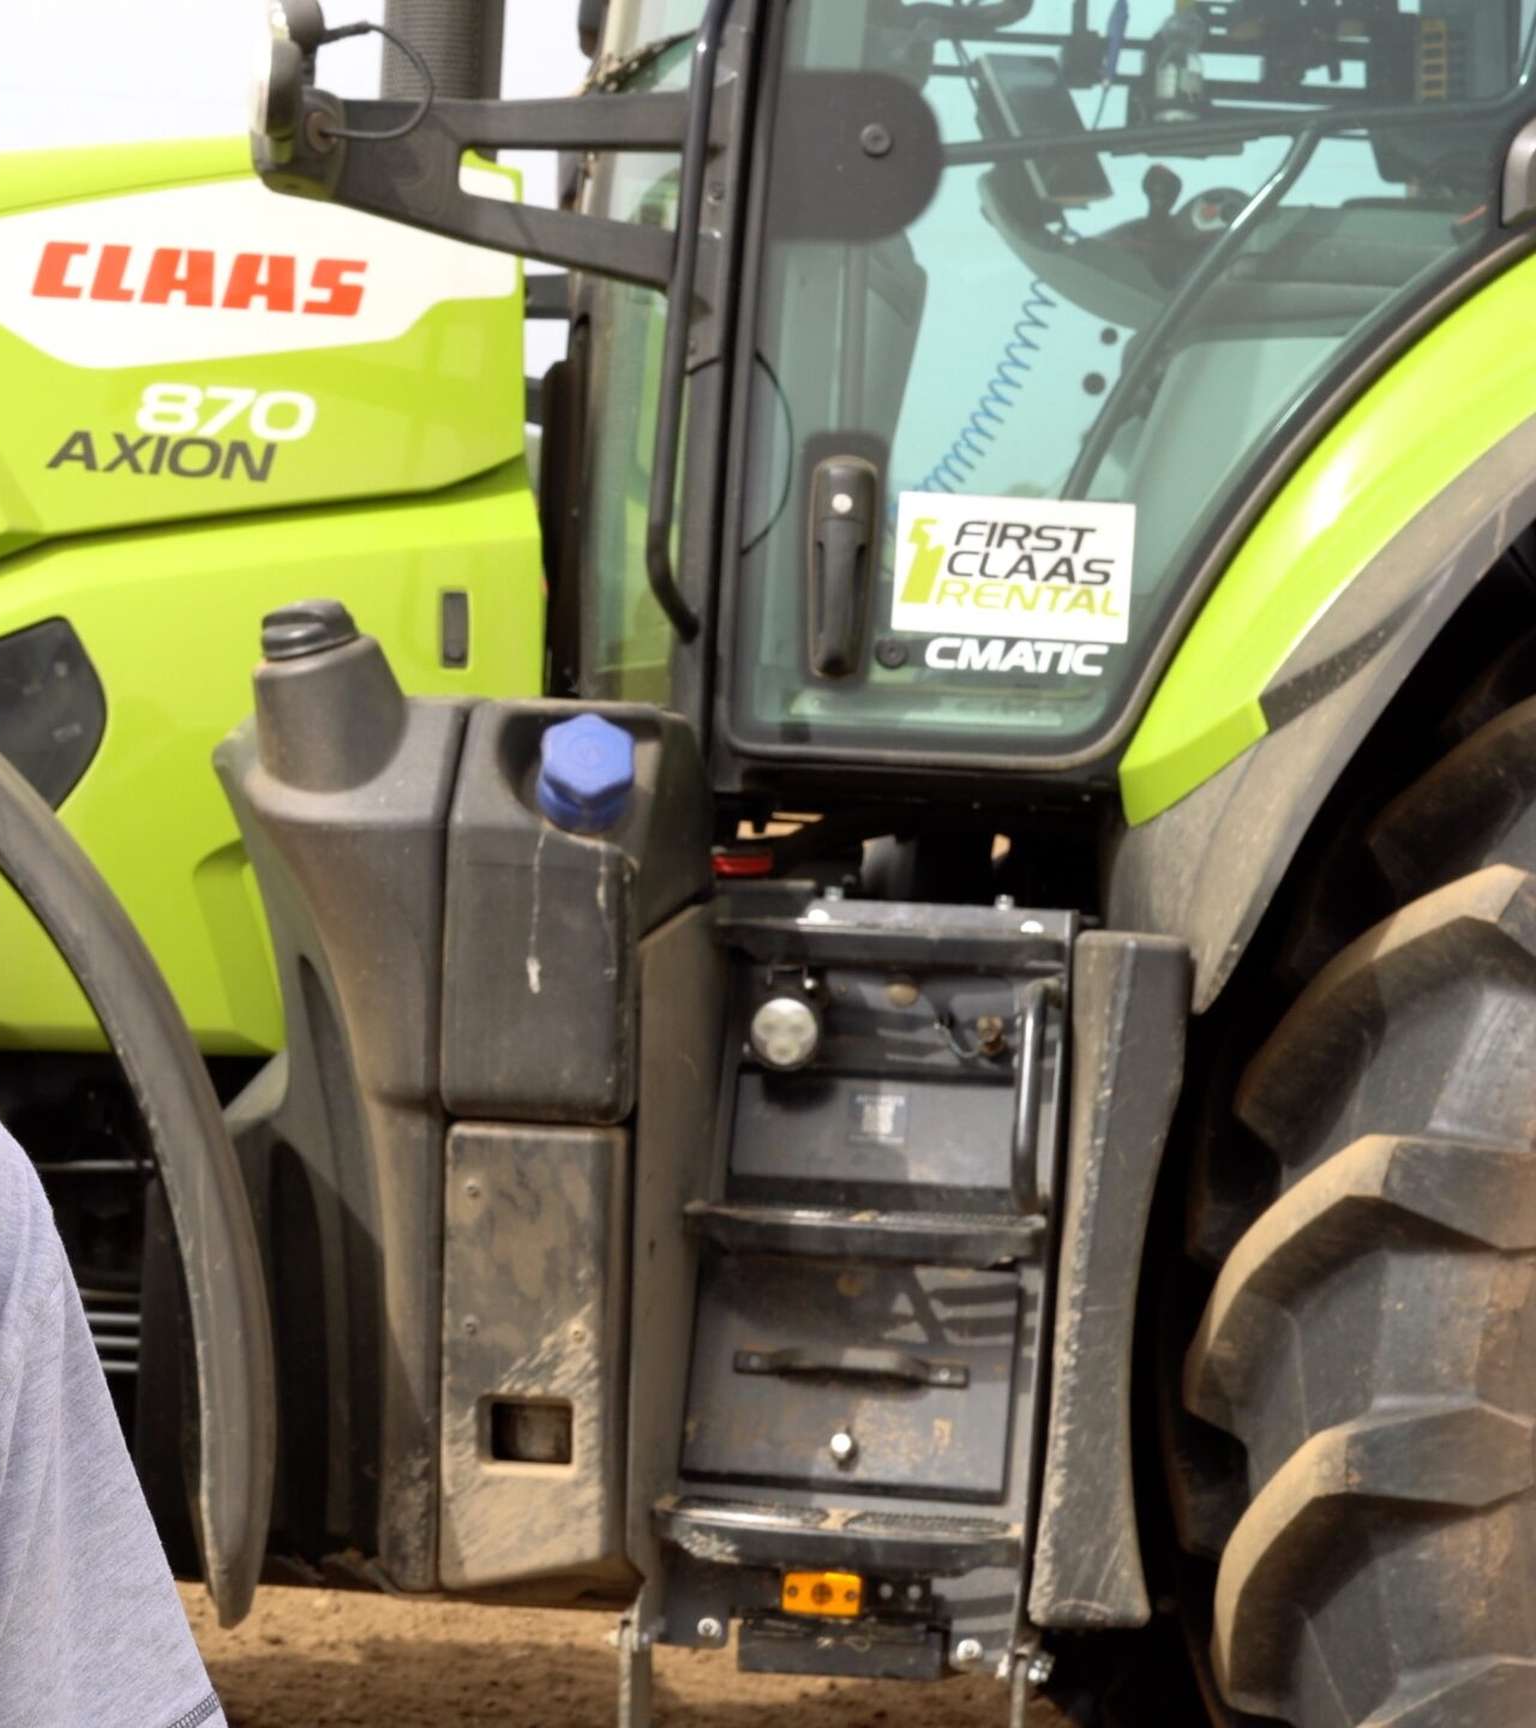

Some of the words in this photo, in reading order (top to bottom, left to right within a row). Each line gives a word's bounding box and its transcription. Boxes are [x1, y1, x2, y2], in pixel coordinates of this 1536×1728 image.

[31, 241, 367, 316] CLAAS
[135, 383, 317, 440] 870
[45, 430, 276, 482] AXION
[954, 521, 1096, 554] FIRST
[947, 551, 1115, 585] CLAAS
[935, 579, 1121, 616] RENTAL
[924, 637, 1109, 677] CMATIC
